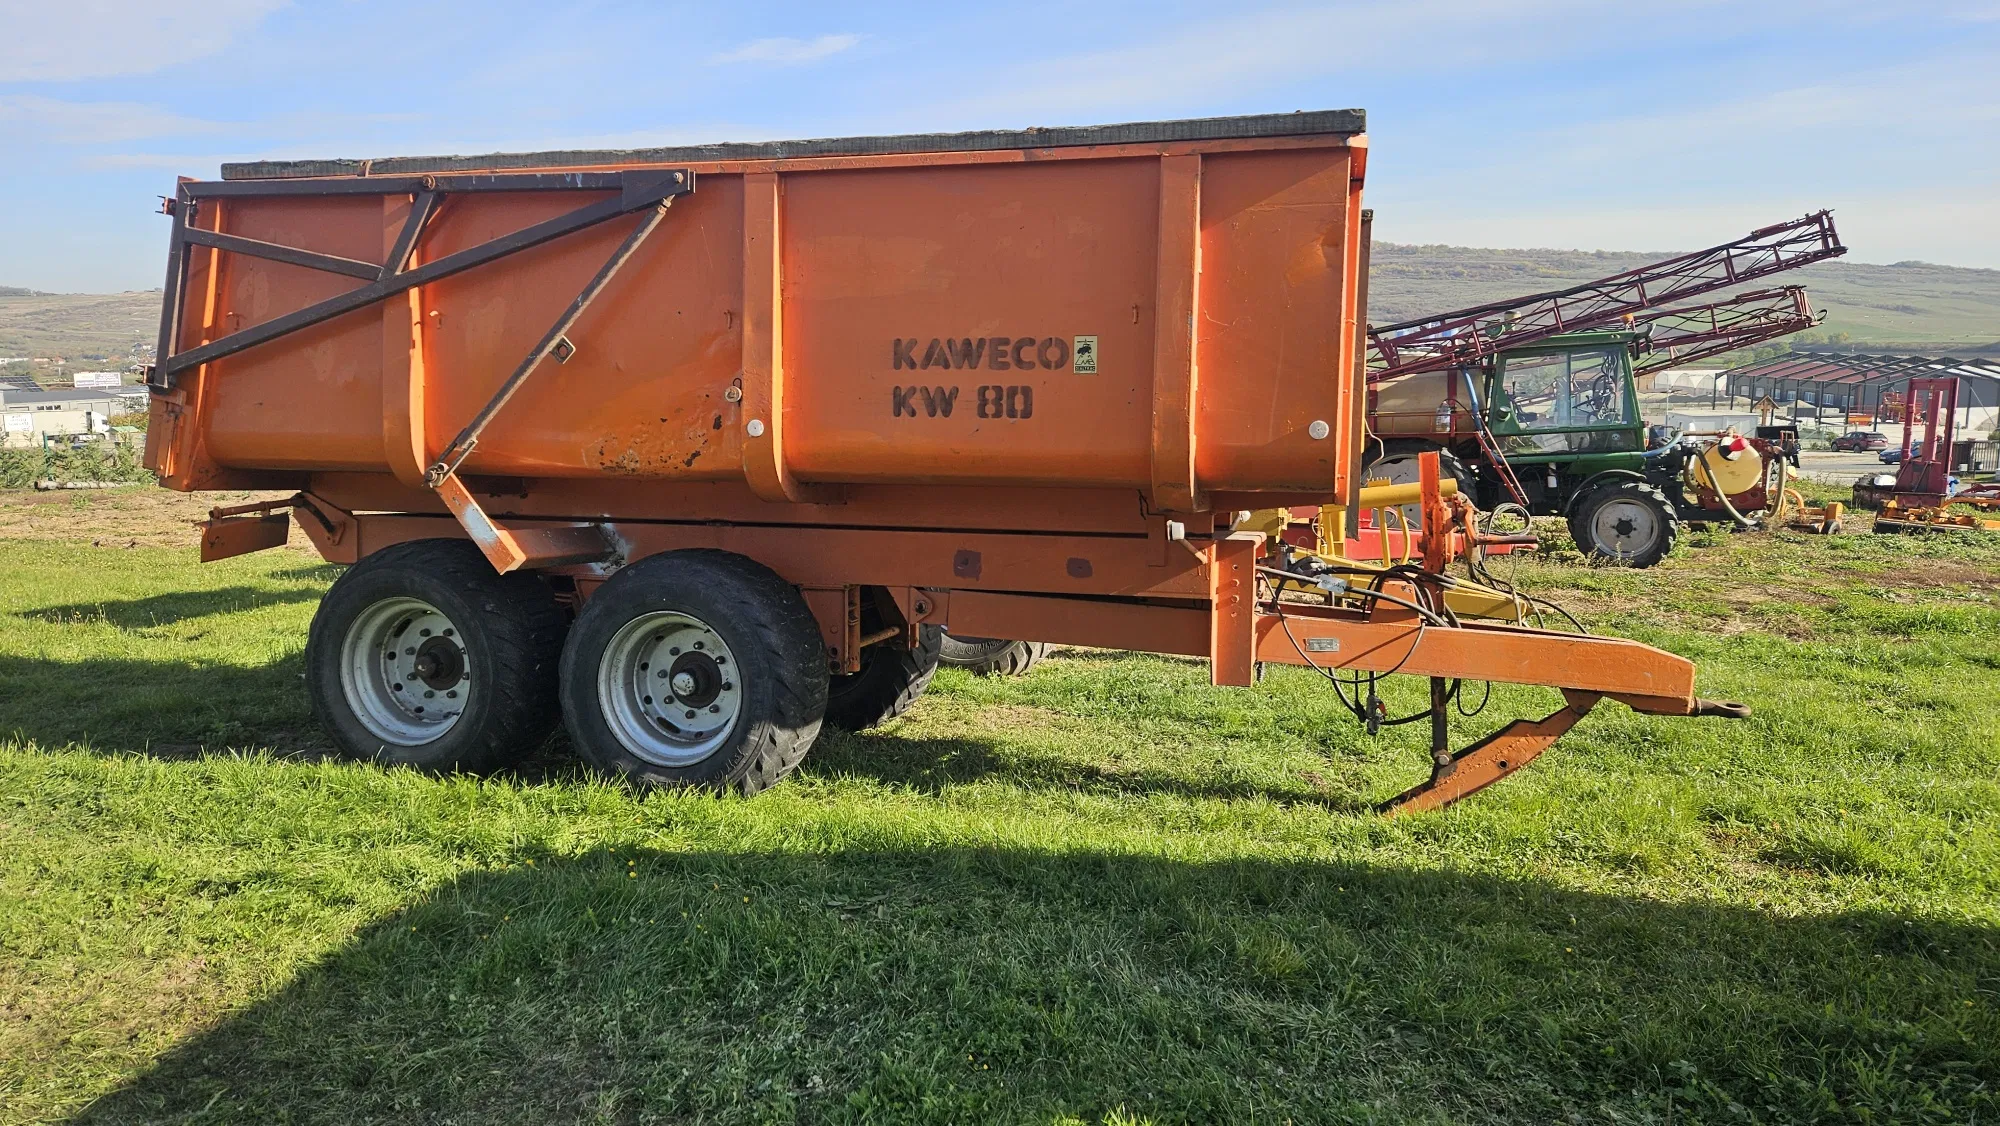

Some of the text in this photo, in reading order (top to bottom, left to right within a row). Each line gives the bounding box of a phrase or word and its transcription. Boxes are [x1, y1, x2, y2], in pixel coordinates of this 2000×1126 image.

[893, 337, 1070, 371] KAWECO
[893, 385, 1033, 419] KW 80
